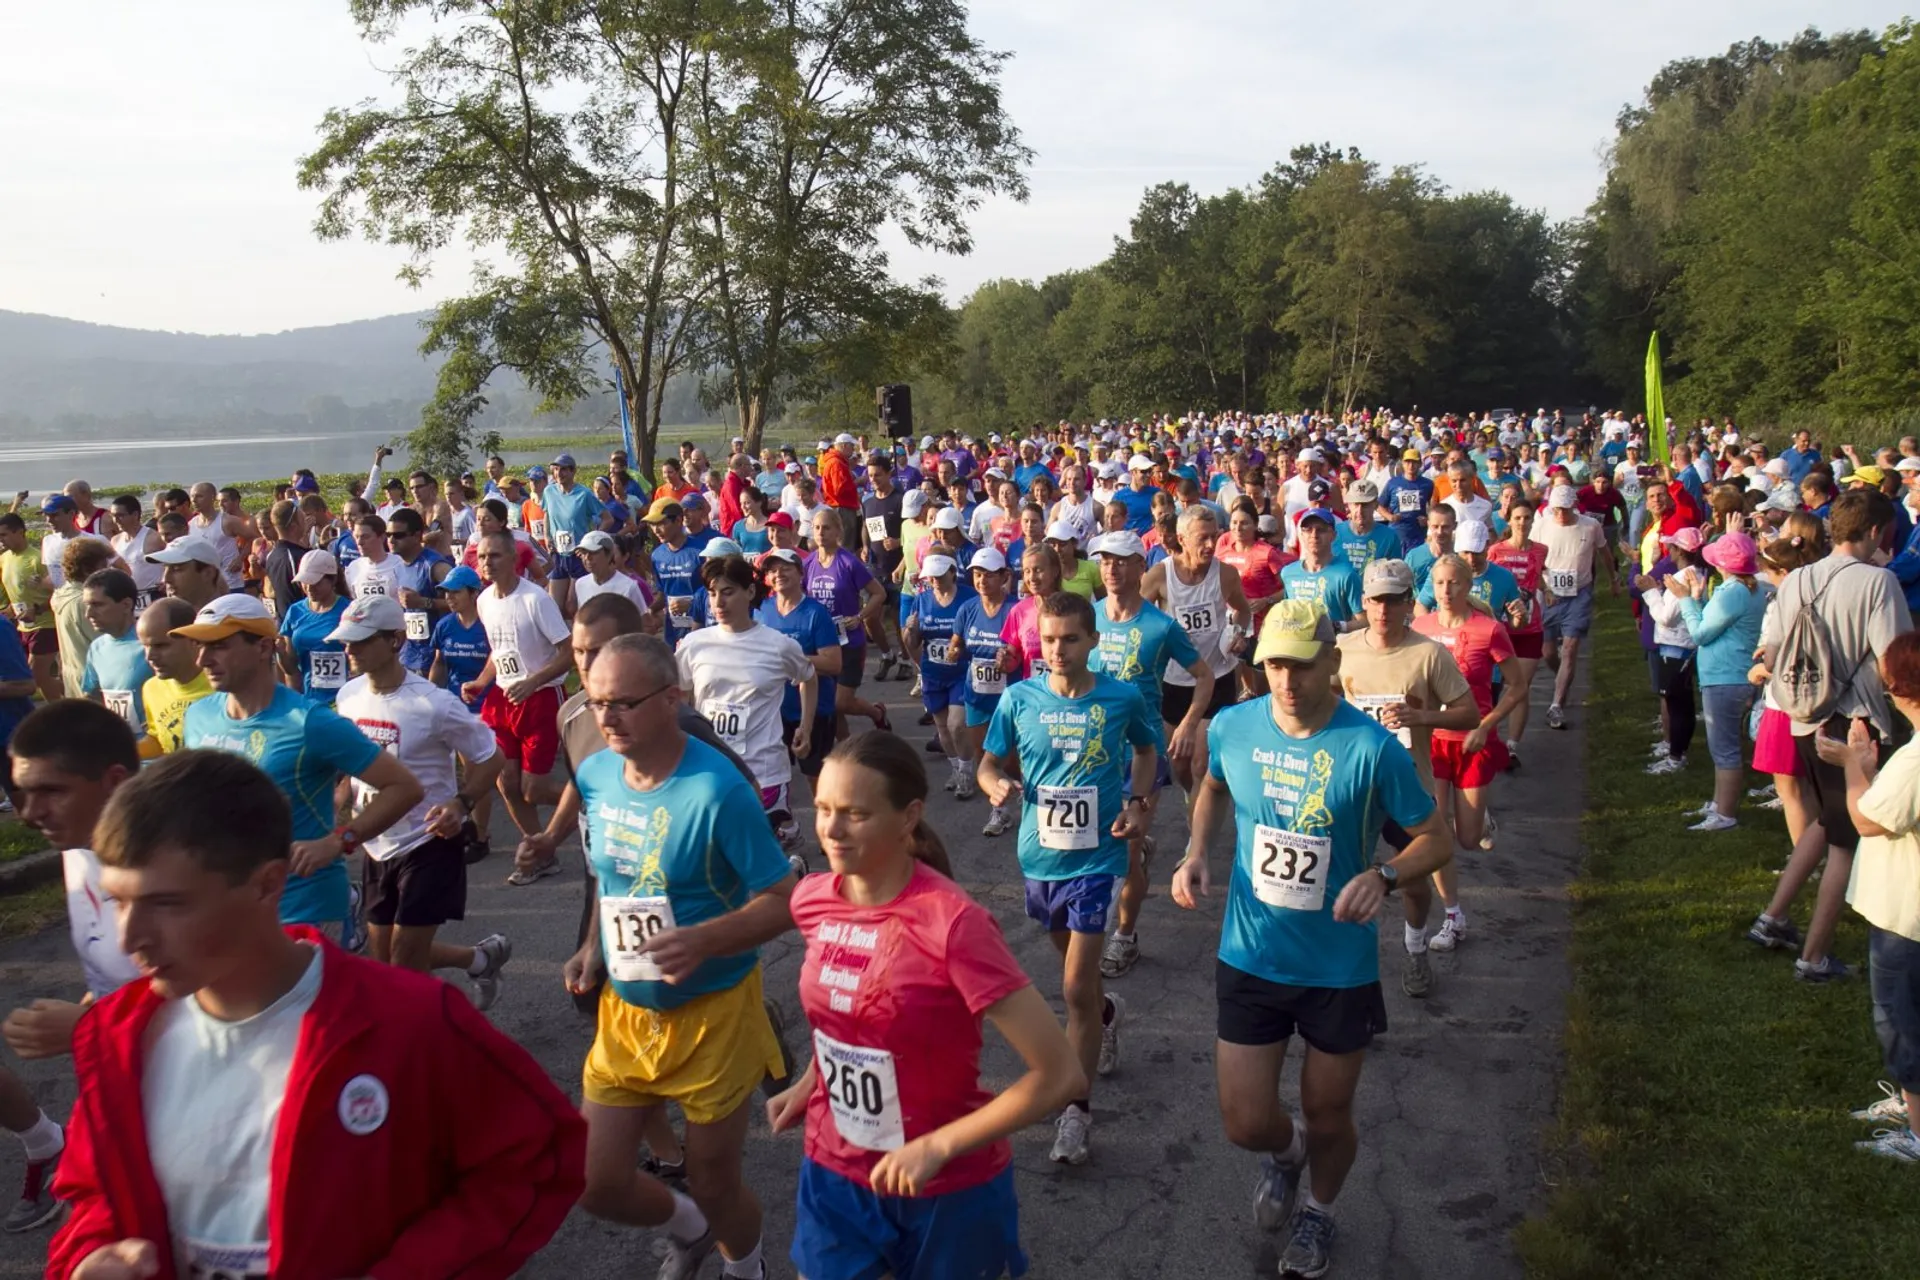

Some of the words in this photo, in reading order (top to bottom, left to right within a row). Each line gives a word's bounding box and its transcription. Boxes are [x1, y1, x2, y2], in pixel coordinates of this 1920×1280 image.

[1401, 494, 1417, 504] 602
[1553, 575, 1574, 587] 108
[1182, 609, 1212, 632] 363
[930, 644, 950, 660] 64
[314, 658, 341, 676] 552
[1275, 751, 1282, 767] &
[1283, 753, 1309, 773] Slovak
[1264, 781, 1300, 803] Marathon
[1044, 799, 1090, 828] 720
[1275, 838, 1309, 850] MARATHON
[1260, 842, 1319, 885] 232
[823, 1053, 884, 1117] 260
